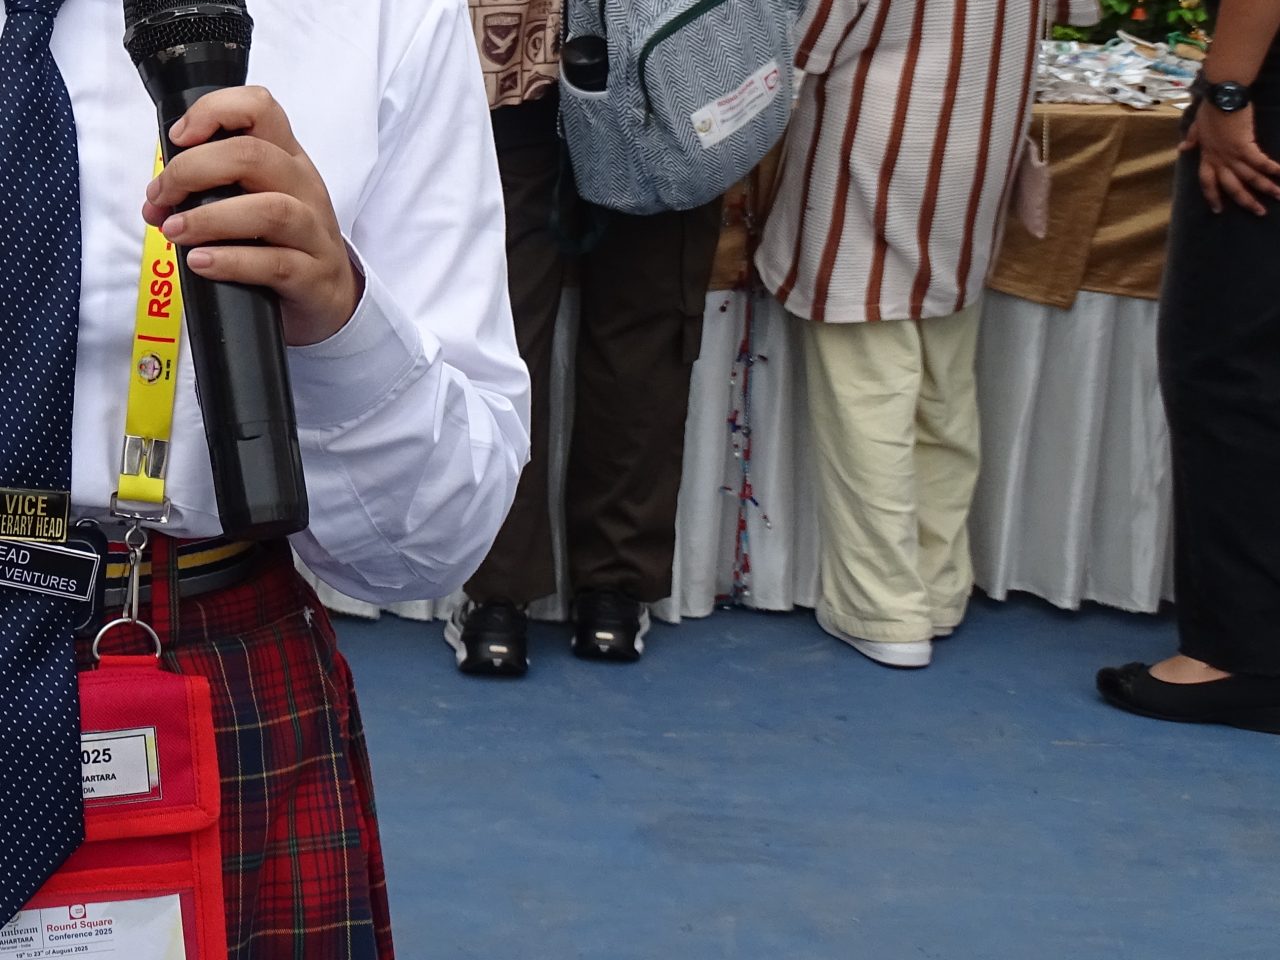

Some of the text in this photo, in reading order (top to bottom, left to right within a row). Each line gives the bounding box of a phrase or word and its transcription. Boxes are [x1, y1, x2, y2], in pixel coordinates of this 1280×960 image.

[147, 259, 175, 319] RSC
[5, 494, 48, 516] VICE
[35, 516, 63, 538] HEAD
[5, 566, 78, 592] VENTURES
[81, 748, 112, 765] 025
[46, 918, 113, 933] Round Square
[48, 927, 113, 942] Conference 2025
[51, 947, 73, 955] August
